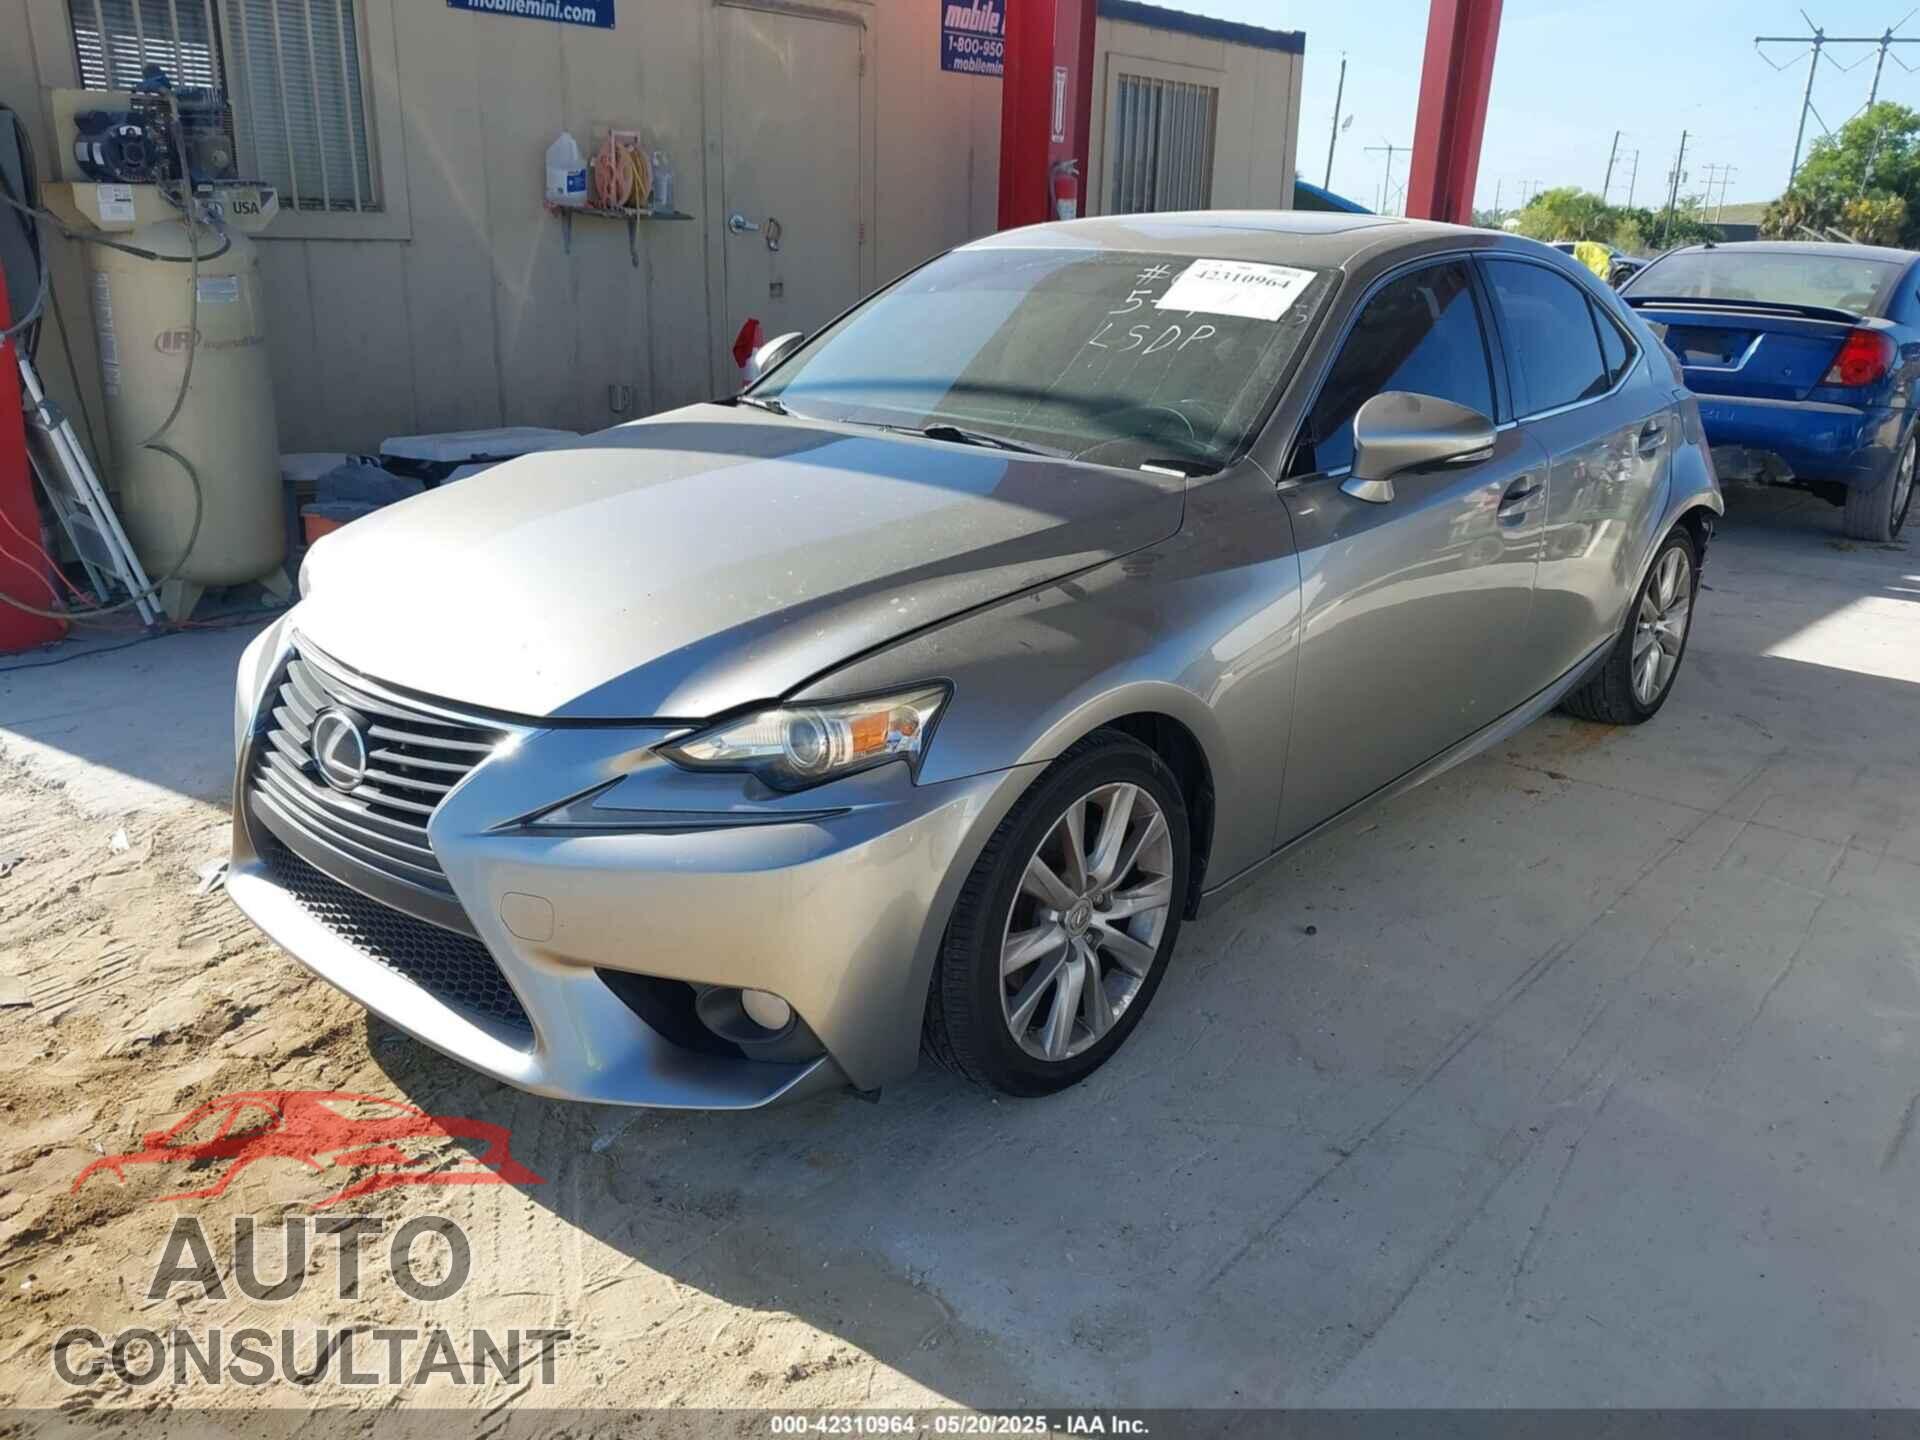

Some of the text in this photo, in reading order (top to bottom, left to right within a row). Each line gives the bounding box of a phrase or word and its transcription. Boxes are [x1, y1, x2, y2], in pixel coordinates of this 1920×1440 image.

[944, 0, 1000, 34] mobile
[948, 35, 1003, 57] 1-800-950
[232, 202, 260, 215] USA
